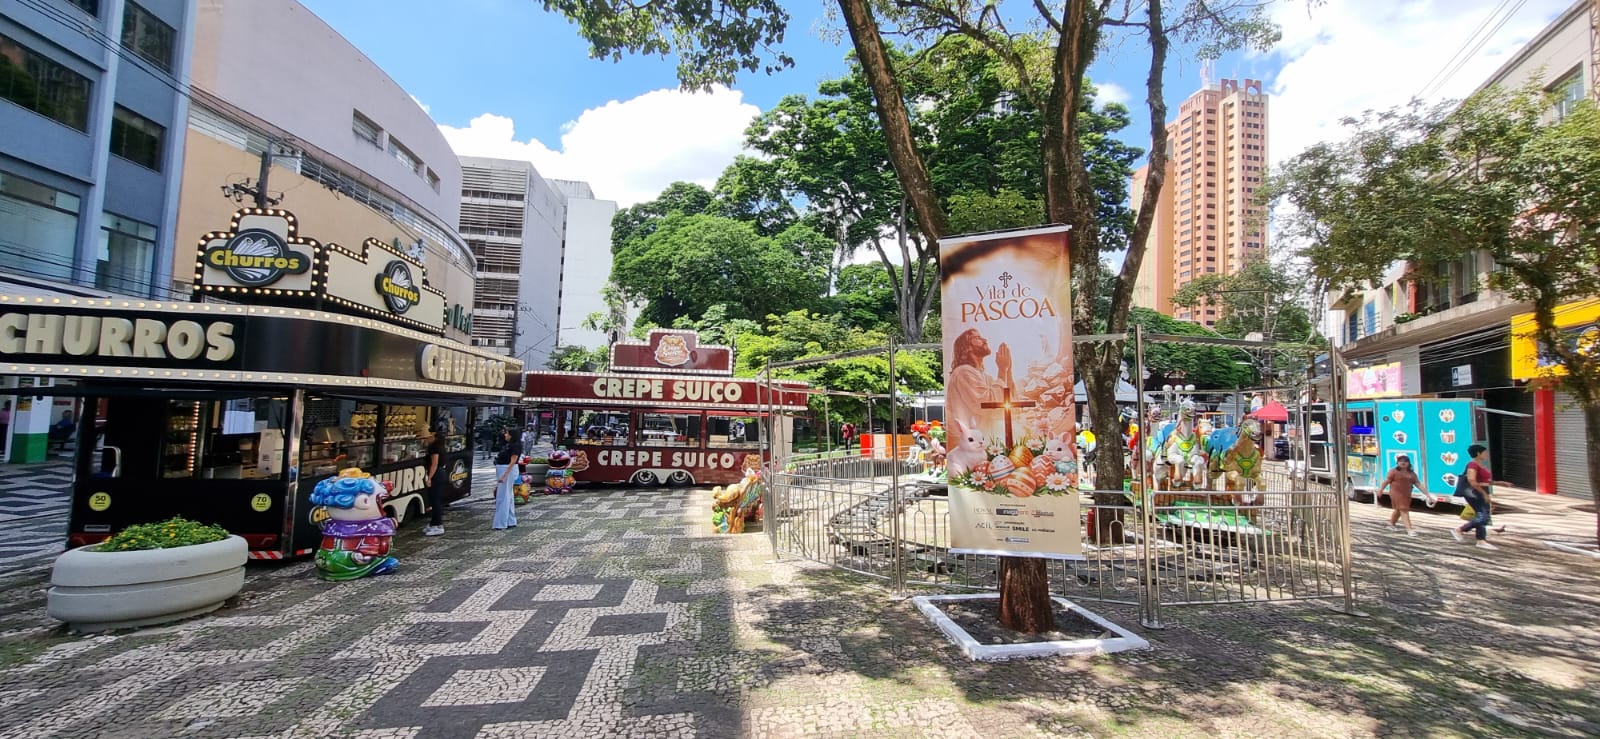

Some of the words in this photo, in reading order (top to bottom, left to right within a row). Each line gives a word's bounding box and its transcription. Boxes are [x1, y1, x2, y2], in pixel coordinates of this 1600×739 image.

[210, 249, 299, 269] Churros
[382, 277, 418, 302] Churros
[976, 285, 1005, 300] Vila
[1011, 283, 1031, 298] de
[0, 313, 235, 362] CHURROS
[421, 343, 506, 389] CHURROS
[593, 378, 663, 399] CREPE
[672, 381, 742, 402] SUIÇO
[597, 450, 662, 467] CREPE
[671, 452, 735, 469] SUIÇO
